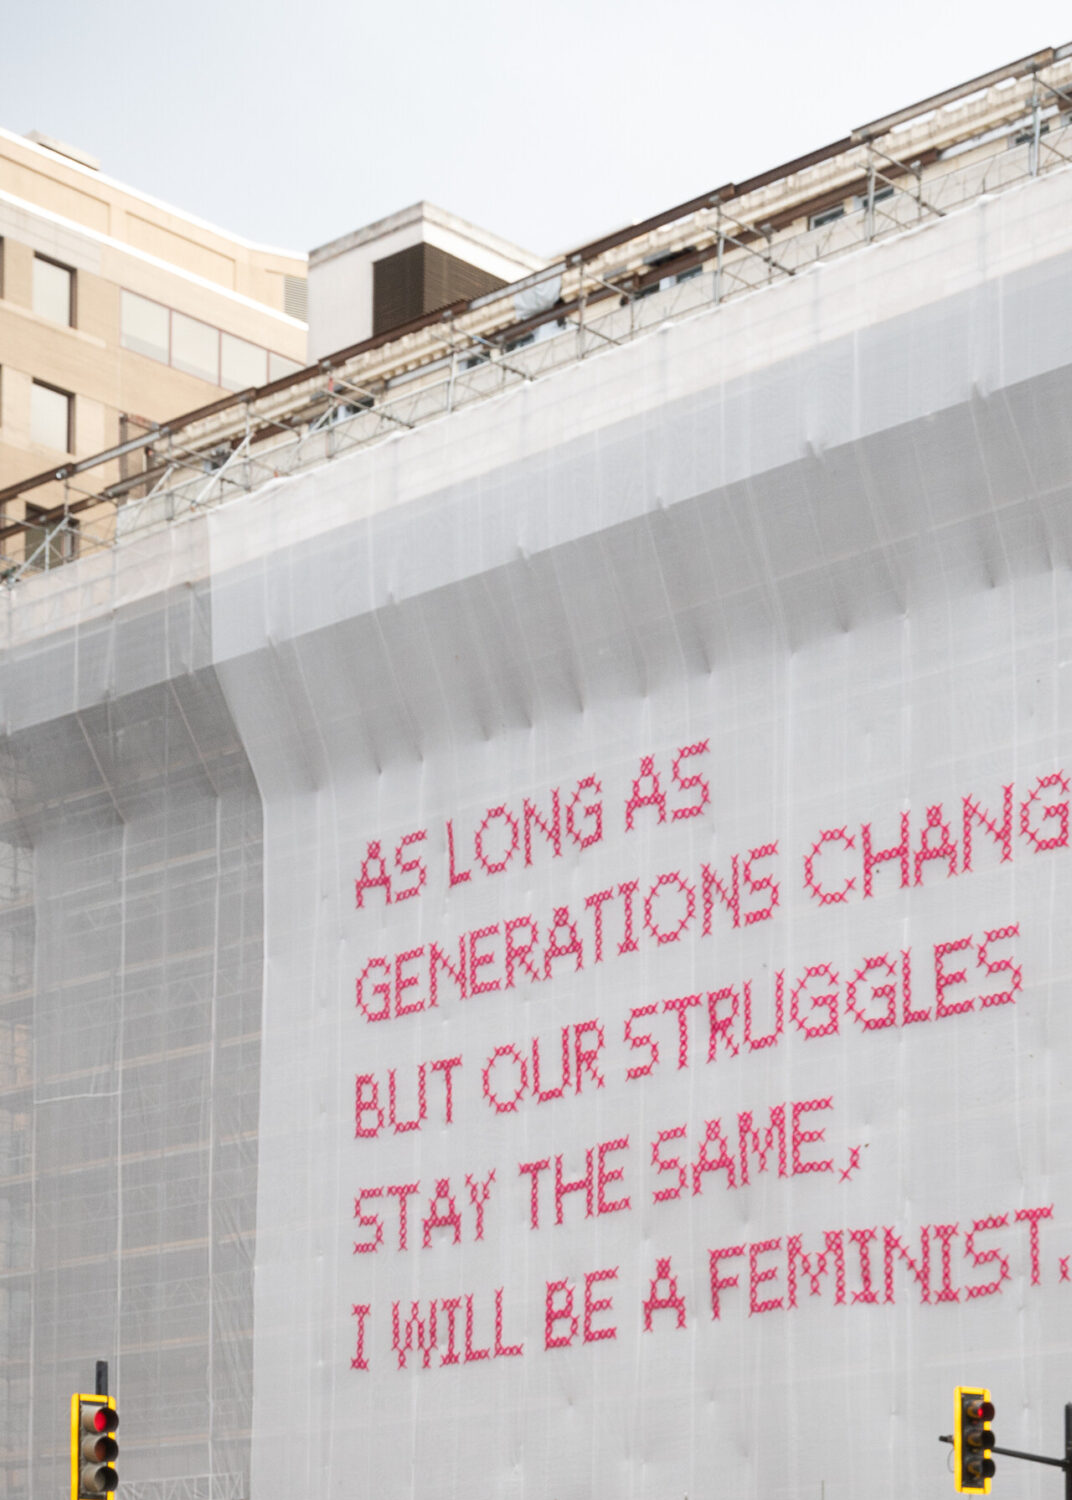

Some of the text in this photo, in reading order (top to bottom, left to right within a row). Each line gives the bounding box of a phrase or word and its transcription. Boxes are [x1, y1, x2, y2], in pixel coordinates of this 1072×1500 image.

[355, 739, 710, 908] AS LONG AS
[355, 842, 779, 1022] GENERATIONS
[355, 924, 1023, 1139] BUT OUR STRUGGLES
[353, 1096, 861, 1254] STAY THE SAME,
[351, 1205, 1070, 1370] I WILL BE A FEMINIST.
